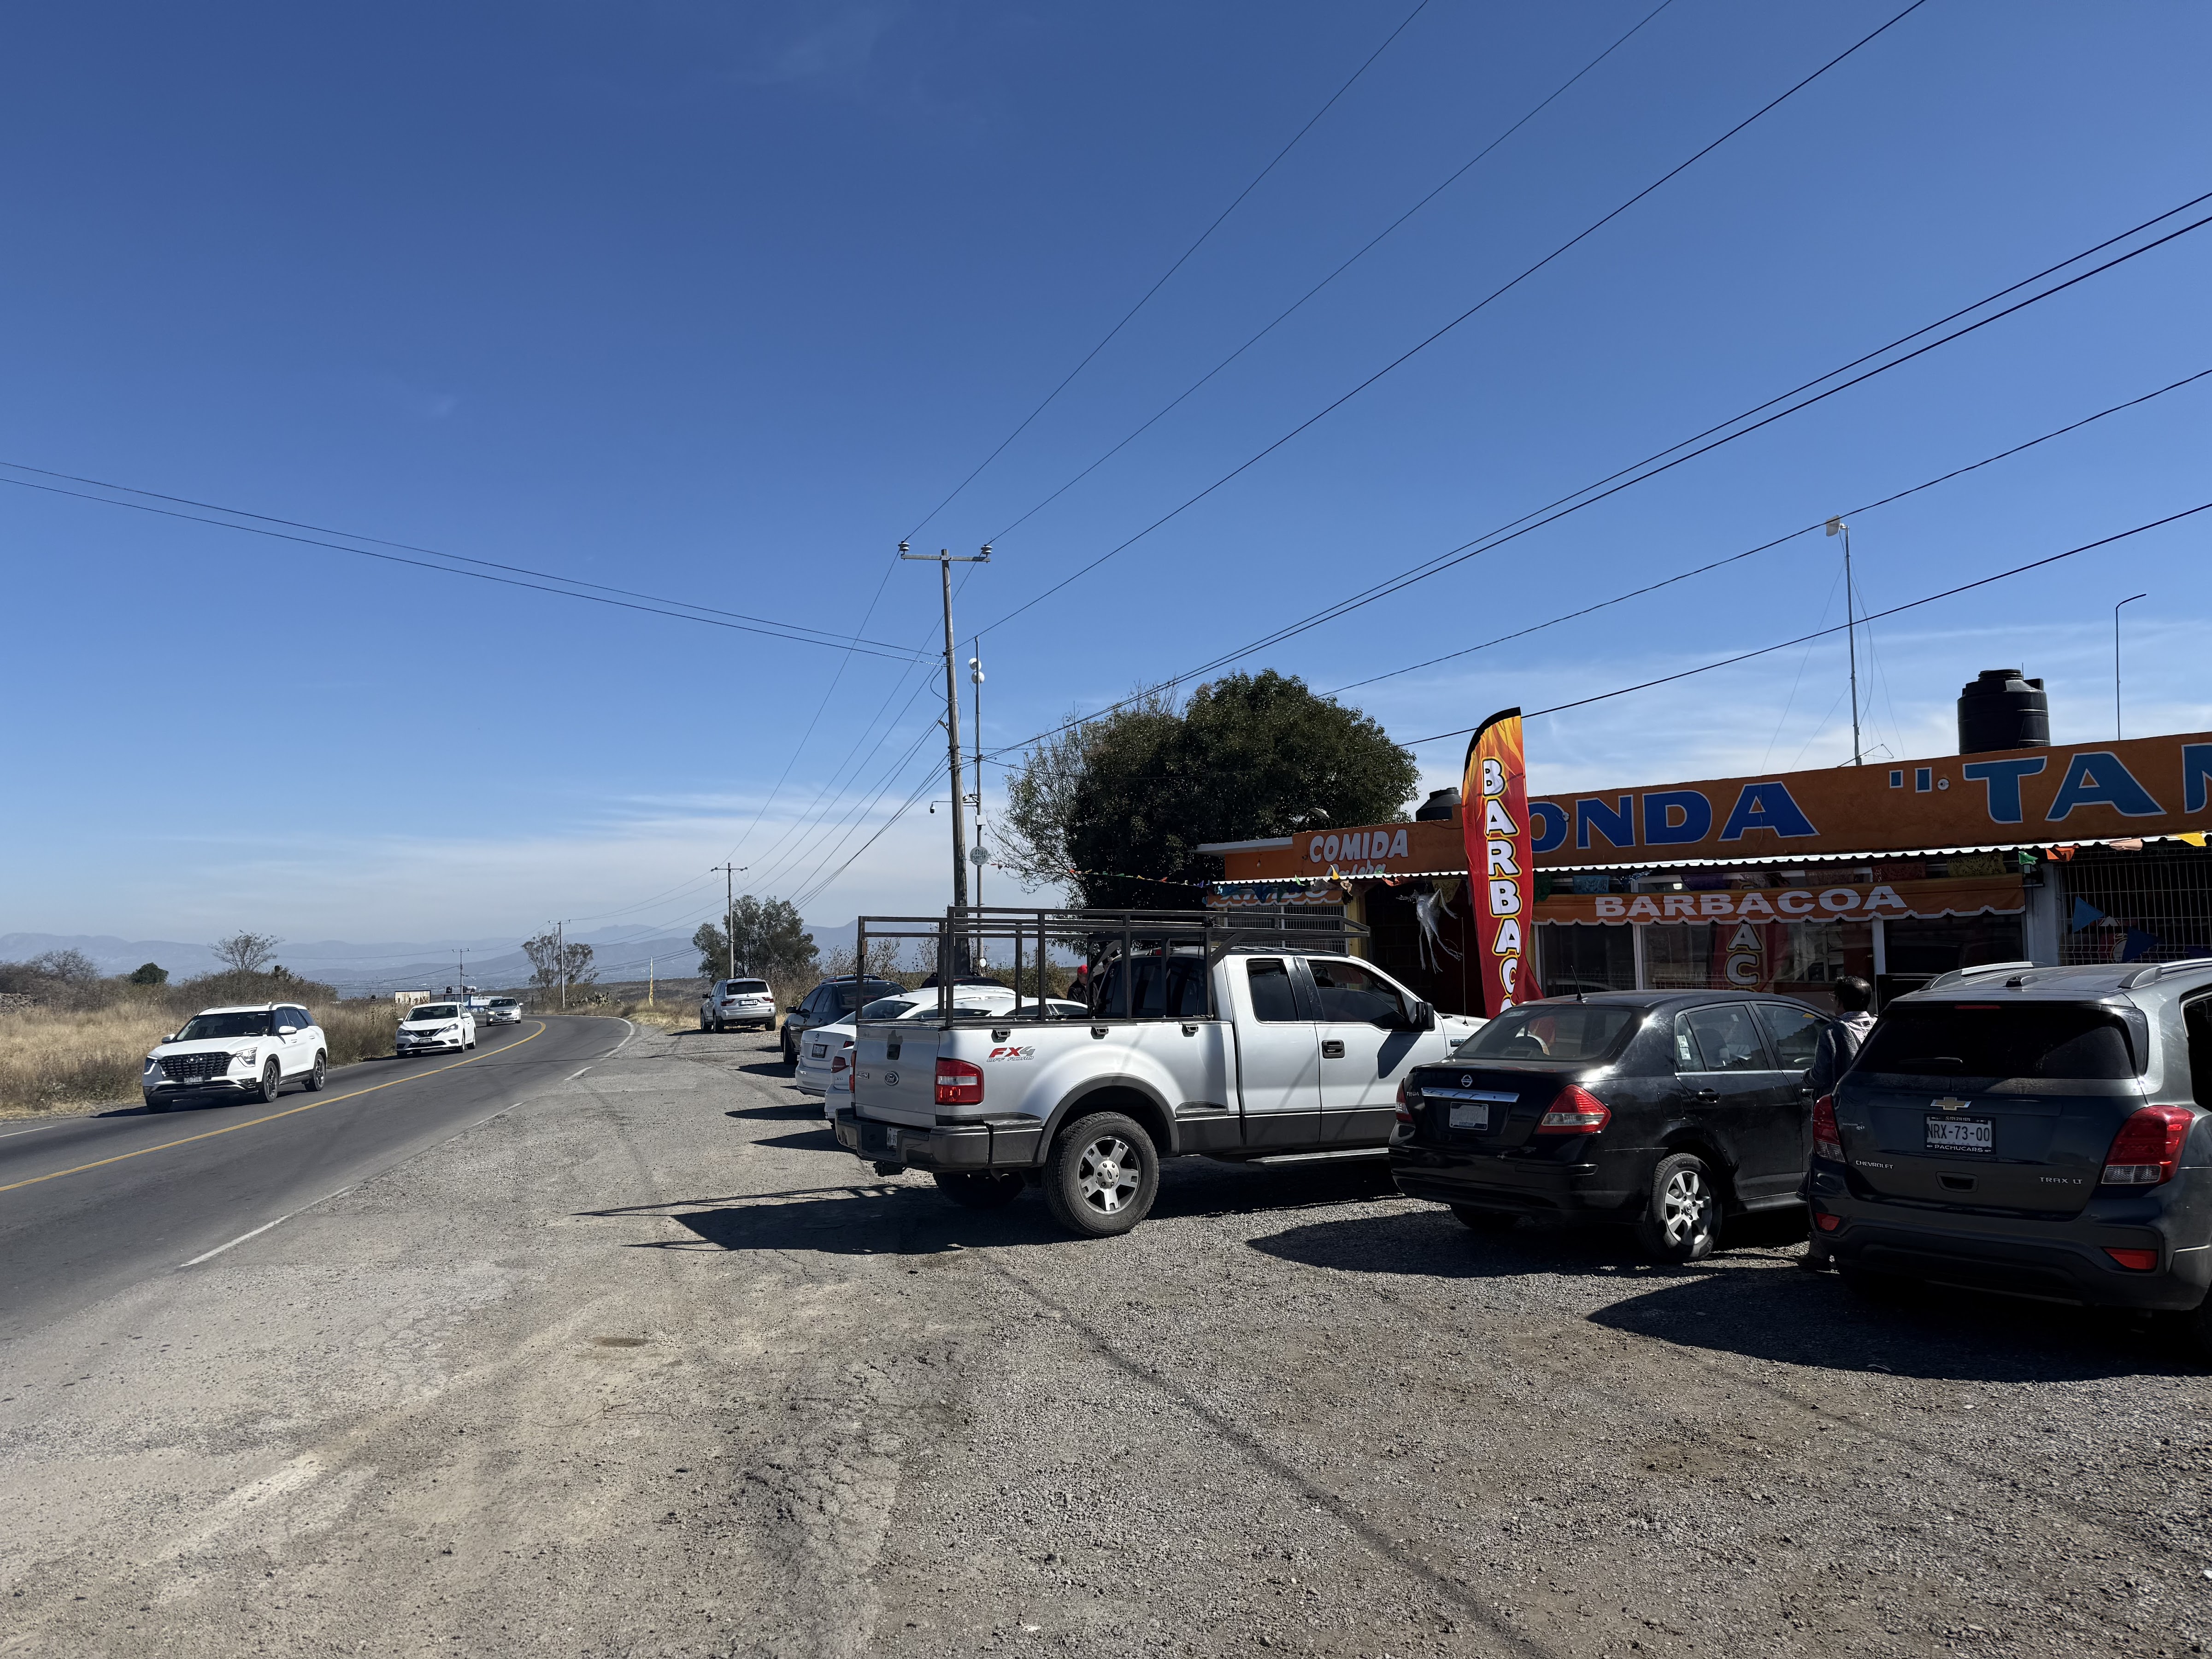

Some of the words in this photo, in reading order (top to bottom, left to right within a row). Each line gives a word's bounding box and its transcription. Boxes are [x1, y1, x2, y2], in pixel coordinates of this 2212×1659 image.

[1528, 781, 1820, 853] ONDA
[1309, 829, 1408, 863] COMIDA
[1481, 757, 1522, 1013] BARBAC
[1595, 886, 1906, 917] BARBACOA
[988, 1046, 1035, 1058] FX4
[1927, 1124, 1990, 1141] NRX-73-00
[1856, 1160, 1894, 1169] CHEVROLET
